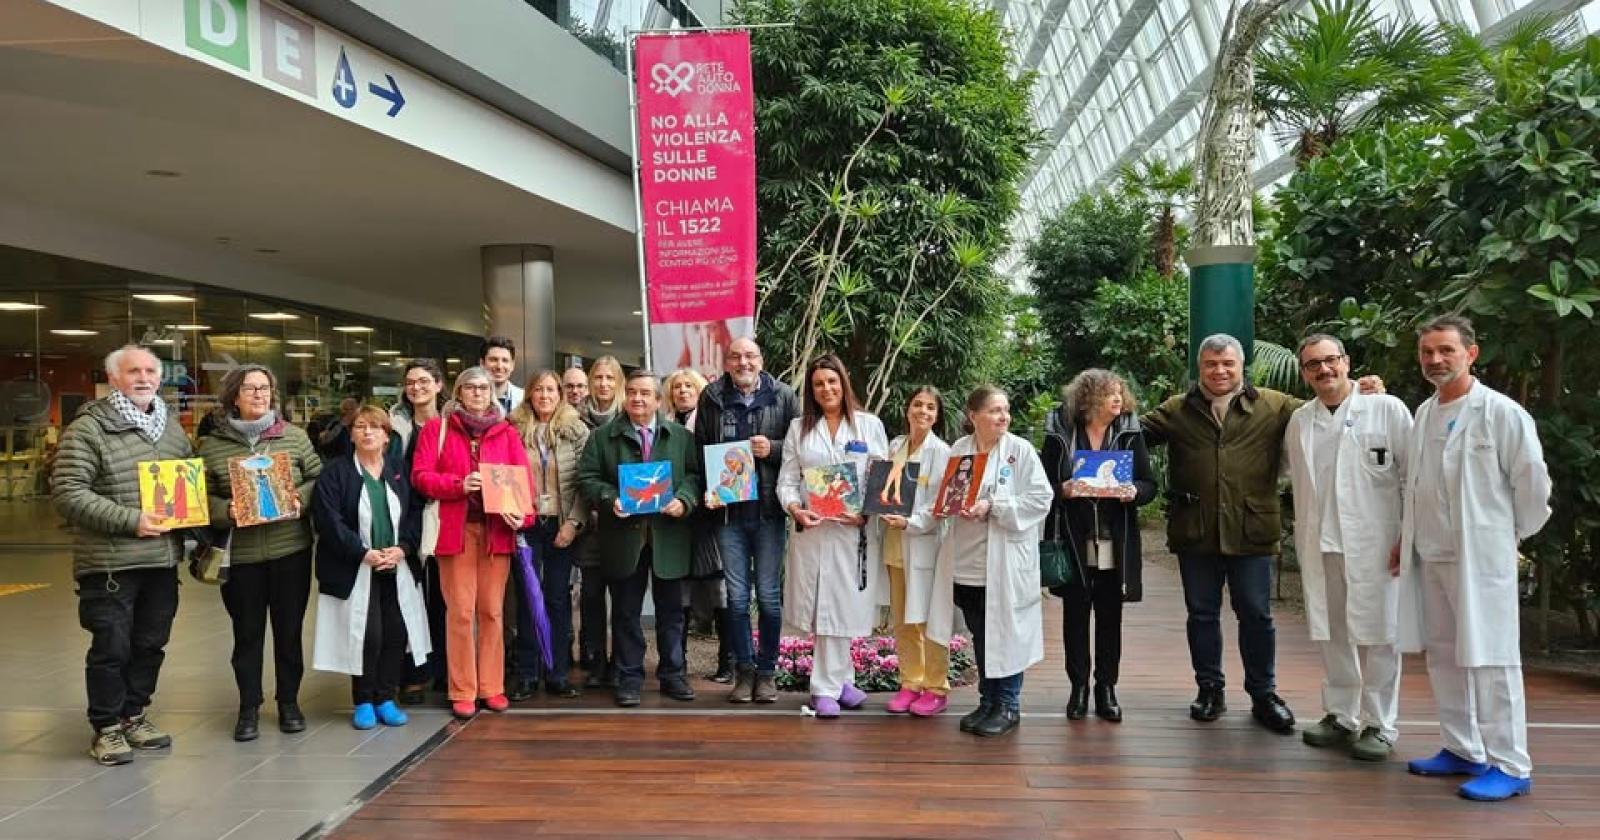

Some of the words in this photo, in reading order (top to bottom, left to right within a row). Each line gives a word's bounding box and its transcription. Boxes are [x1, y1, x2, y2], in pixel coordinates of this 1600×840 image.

[199, 0, 237, 46] D
[275, 20, 302, 80] E
[698, 82, 741, 94] DONNA
[651, 115, 678, 129] NO
[683, 112, 729, 128] ALLA
[652, 130, 741, 146] VIOLENZA
[653, 150, 708, 165] SULLE
[655, 166, 717, 182] DONNE
[656, 197, 734, 216] CHIAMA
[657, 220, 675, 236] IL
[679, 216, 721, 235] 1522
